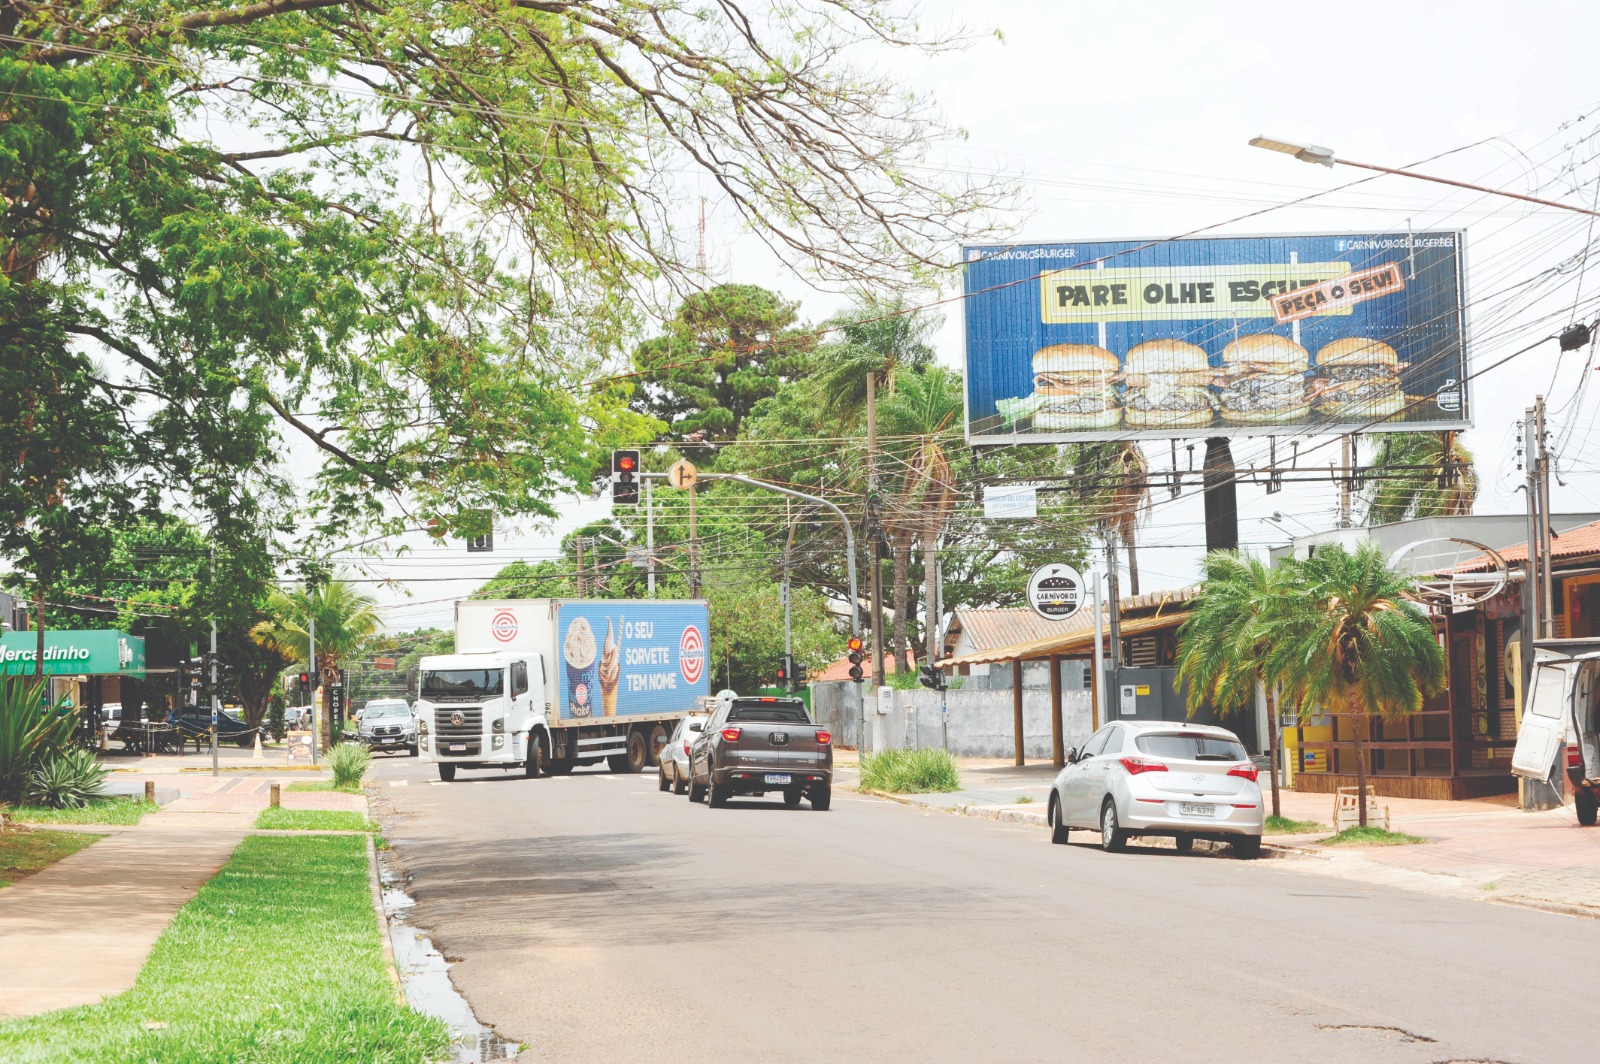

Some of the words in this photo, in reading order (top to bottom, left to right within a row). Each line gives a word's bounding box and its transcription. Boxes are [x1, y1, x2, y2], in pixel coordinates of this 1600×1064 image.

[1346, 237, 1459, 250] CARNIVOROSBURGERBEE
[1056, 283, 1127, 307] PARE
[1143, 282, 1215, 305] OLHE
[1228, 279, 1329, 302] ESCU
[1280, 292, 1328, 315] PEÇA
[1331, 285, 1345, 300] O
[1348, 271, 1394, 295] SEU!
[625, 621, 633, 639] O
[635, 621, 653, 639] SEU
[625, 647, 670, 665] SORVETE
[626, 673, 648, 691] TEM
[649, 672, 677, 690] NOME
